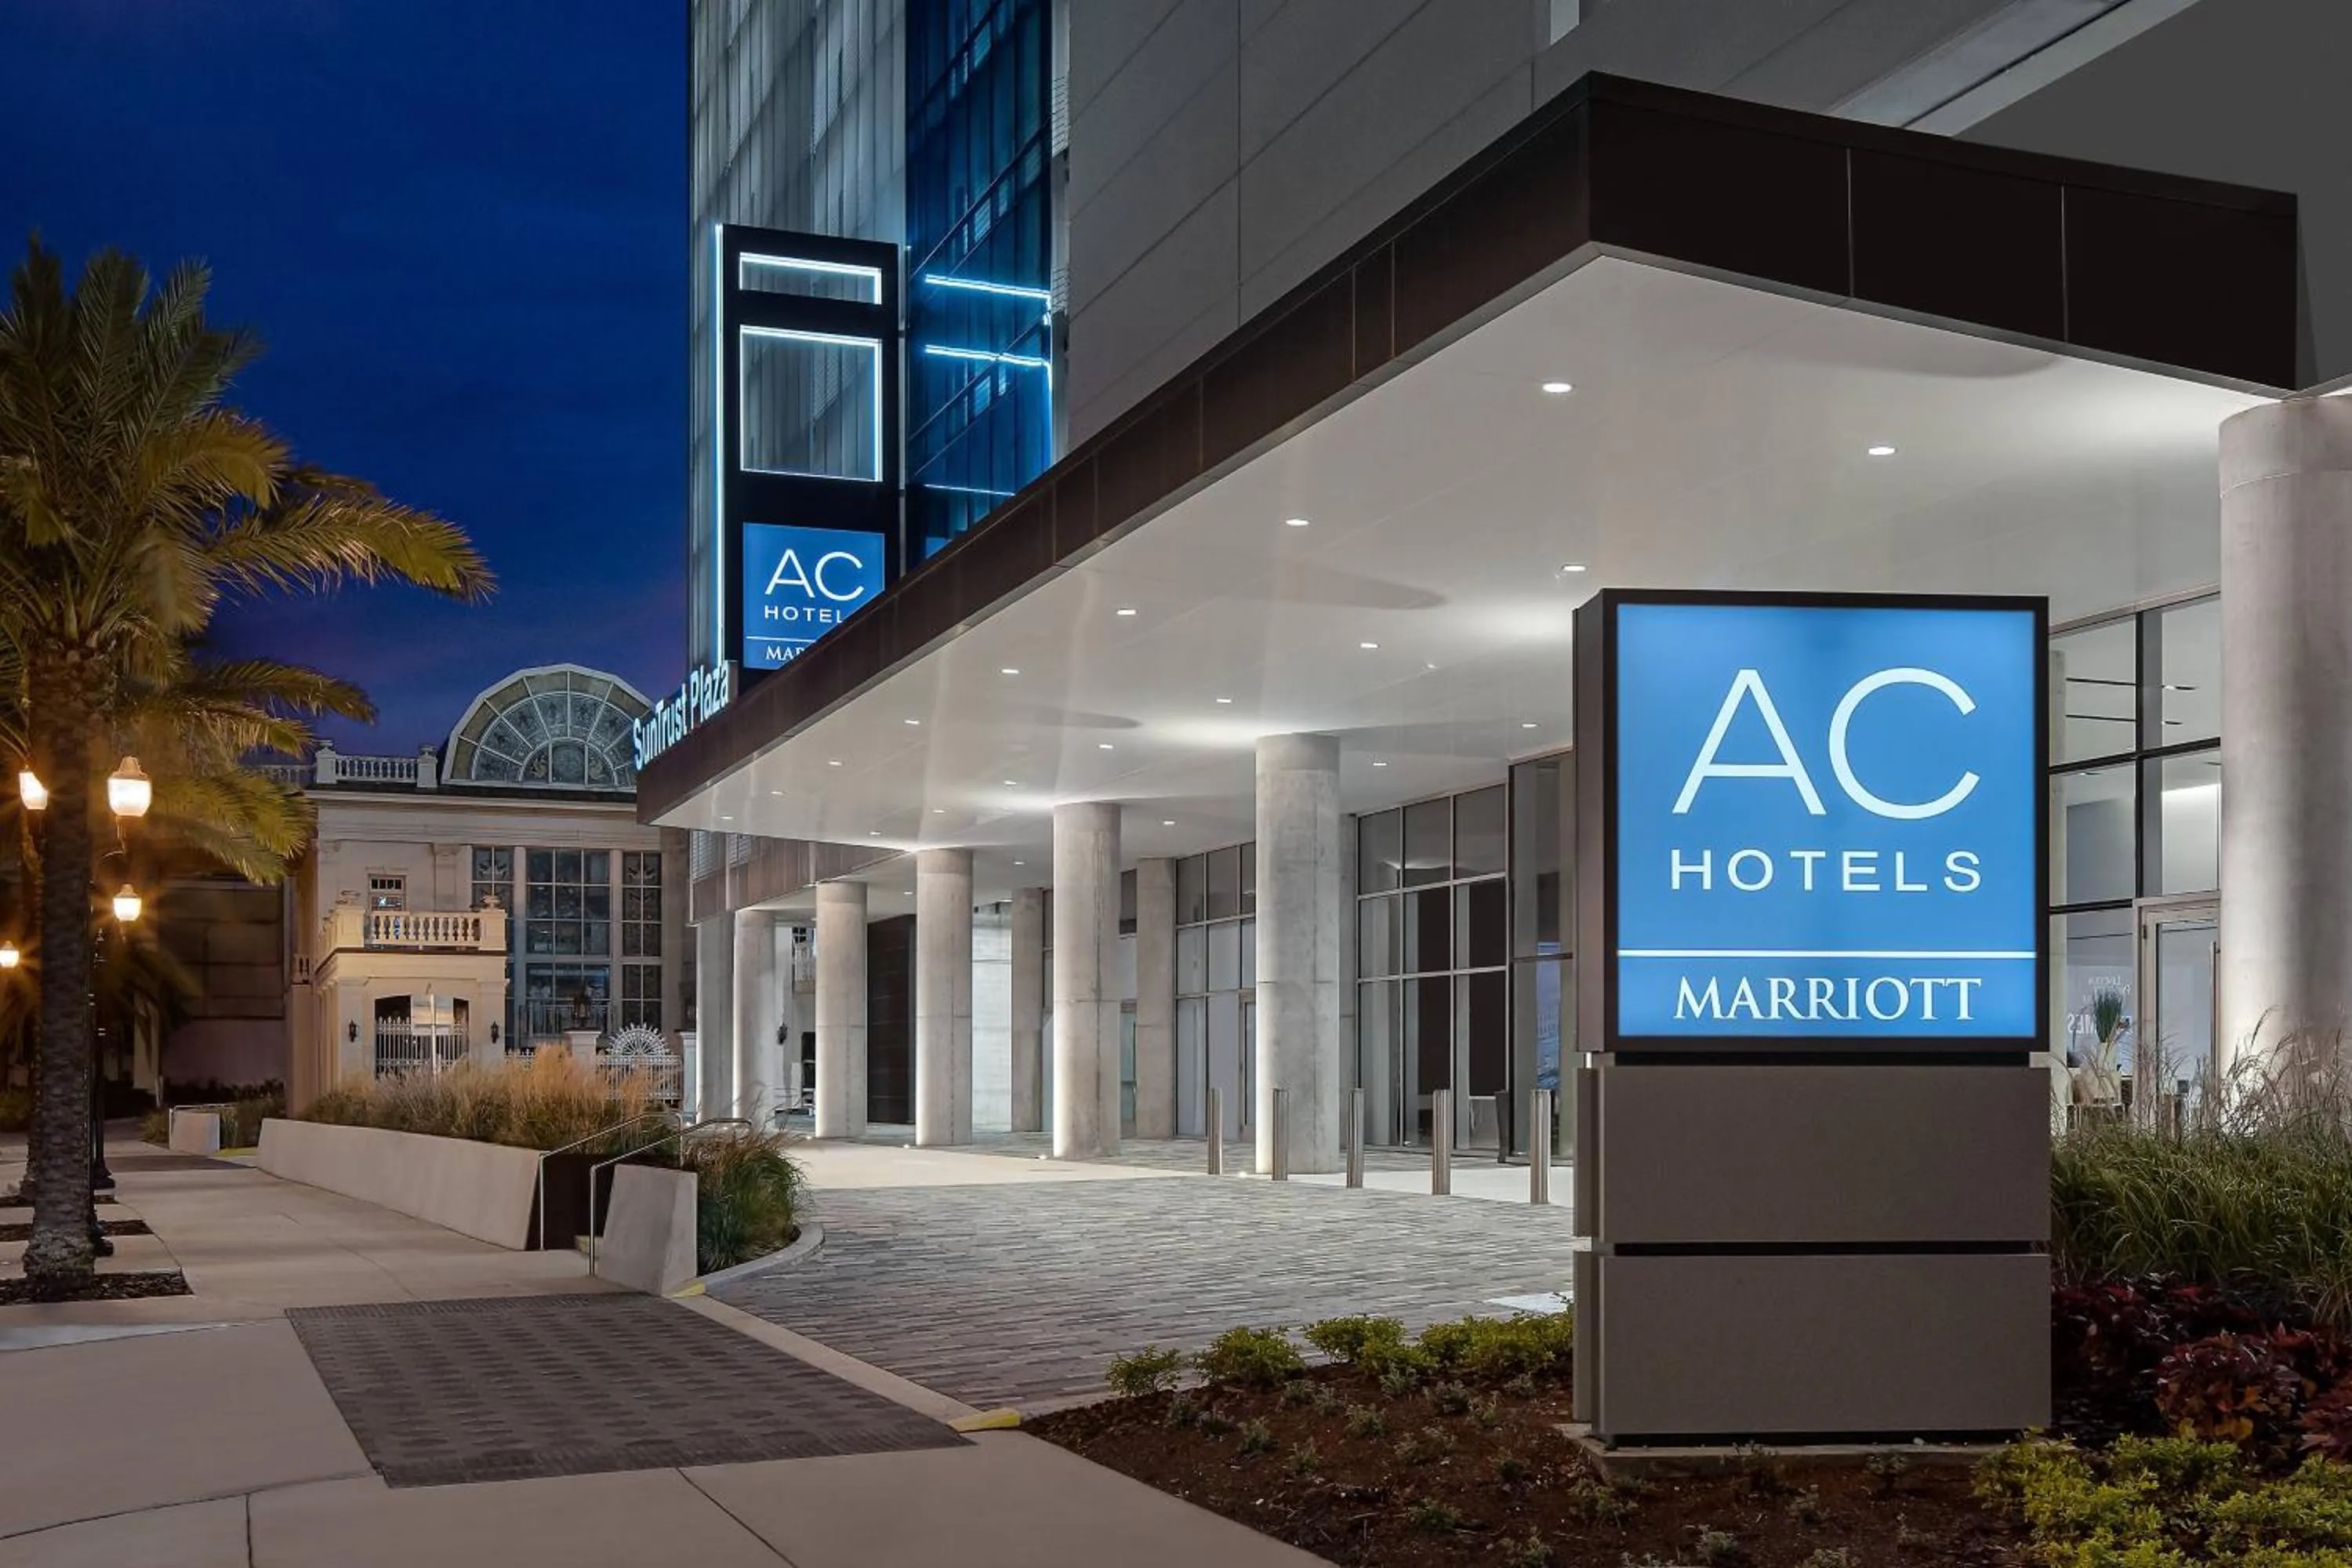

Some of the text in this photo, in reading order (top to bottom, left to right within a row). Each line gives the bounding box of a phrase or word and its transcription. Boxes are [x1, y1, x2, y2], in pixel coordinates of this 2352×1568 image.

[764, 549, 865, 601] AC
[633, 660, 729, 771] SunTrust Plaza
[1671, 667, 1980, 819] AC
[1671, 849, 1982, 892] HOTELS
[1675, 976, 1982, 1020] MARRIOTT
